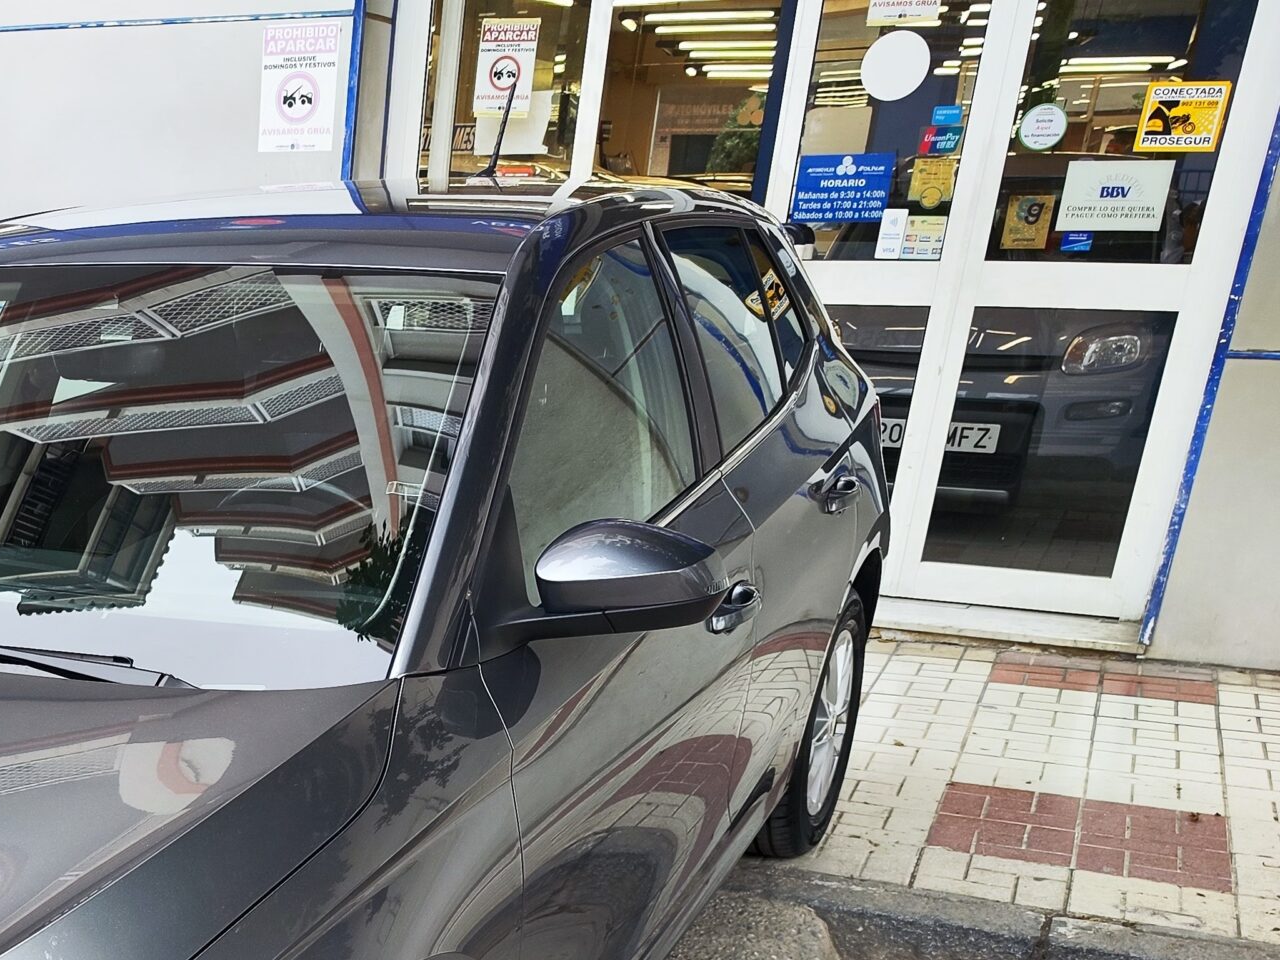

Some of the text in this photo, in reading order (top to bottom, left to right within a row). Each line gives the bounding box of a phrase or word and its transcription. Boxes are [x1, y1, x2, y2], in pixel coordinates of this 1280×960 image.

[484, 23, 537, 31] PROHIBIDO
[267, 25, 337, 40] PROHIBIDO
[483, 31, 536, 41] APARCAR
[266, 38, 336, 54] APARCAR
[1154, 87, 1223, 96] CONECTADA
[261, 128, 305, 136] AVISAMOS
[924, 132, 960, 142] UnionPay
[1141, 136, 1211, 145] PROSEGUR
[820, 179, 866, 187] HORARIO
[798, 191, 828, 199] Mañanas
[830, 191, 838, 199] de
[839, 191, 855, 199] 9:30
[862, 190, 885, 198] 14:00h
[1100, 186, 1132, 198] BBV
[793, 211, 823, 219] Sábados
[860, 210, 882, 218] 14:00h
